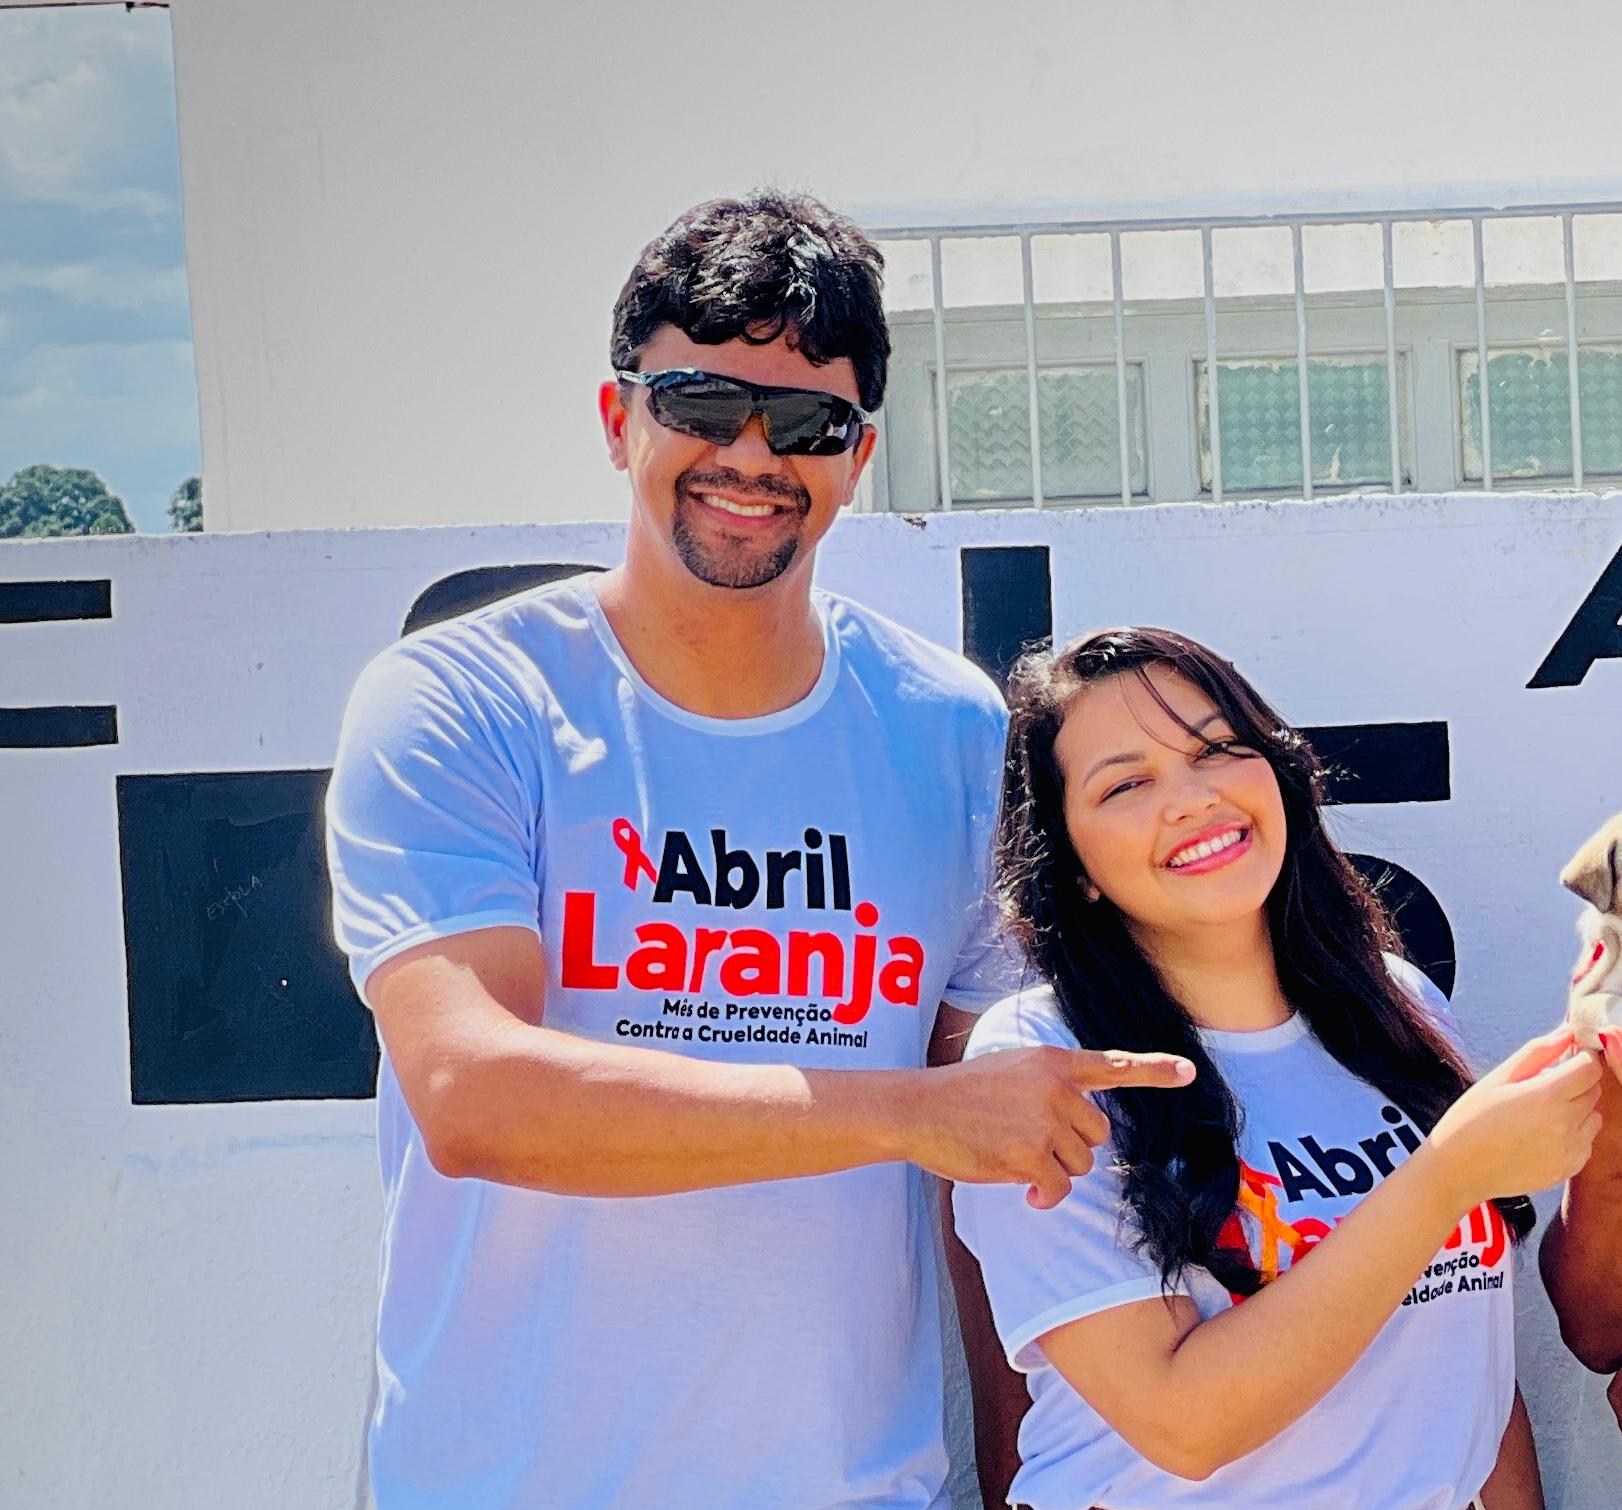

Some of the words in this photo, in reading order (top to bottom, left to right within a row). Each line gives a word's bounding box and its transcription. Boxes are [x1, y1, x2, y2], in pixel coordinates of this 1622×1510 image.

[653, 828, 852, 911] Abril
[561, 892, 924, 1025] Laranja
[663, 998, 693, 1017] Mês
[697, 1002, 720, 1019] de
[726, 1003, 832, 1026] Prevenção
[616, 1019, 679, 1039] Contra
[682, 1028, 693, 1040] a
[698, 1025, 801, 1044] Crueldade
[806, 1027, 868, 1048] Animal
[1268, 1105, 1421, 1203] Abri
[1424, 1252, 1480, 1278] venção
[1402, 1281, 1453, 1306] eldade
